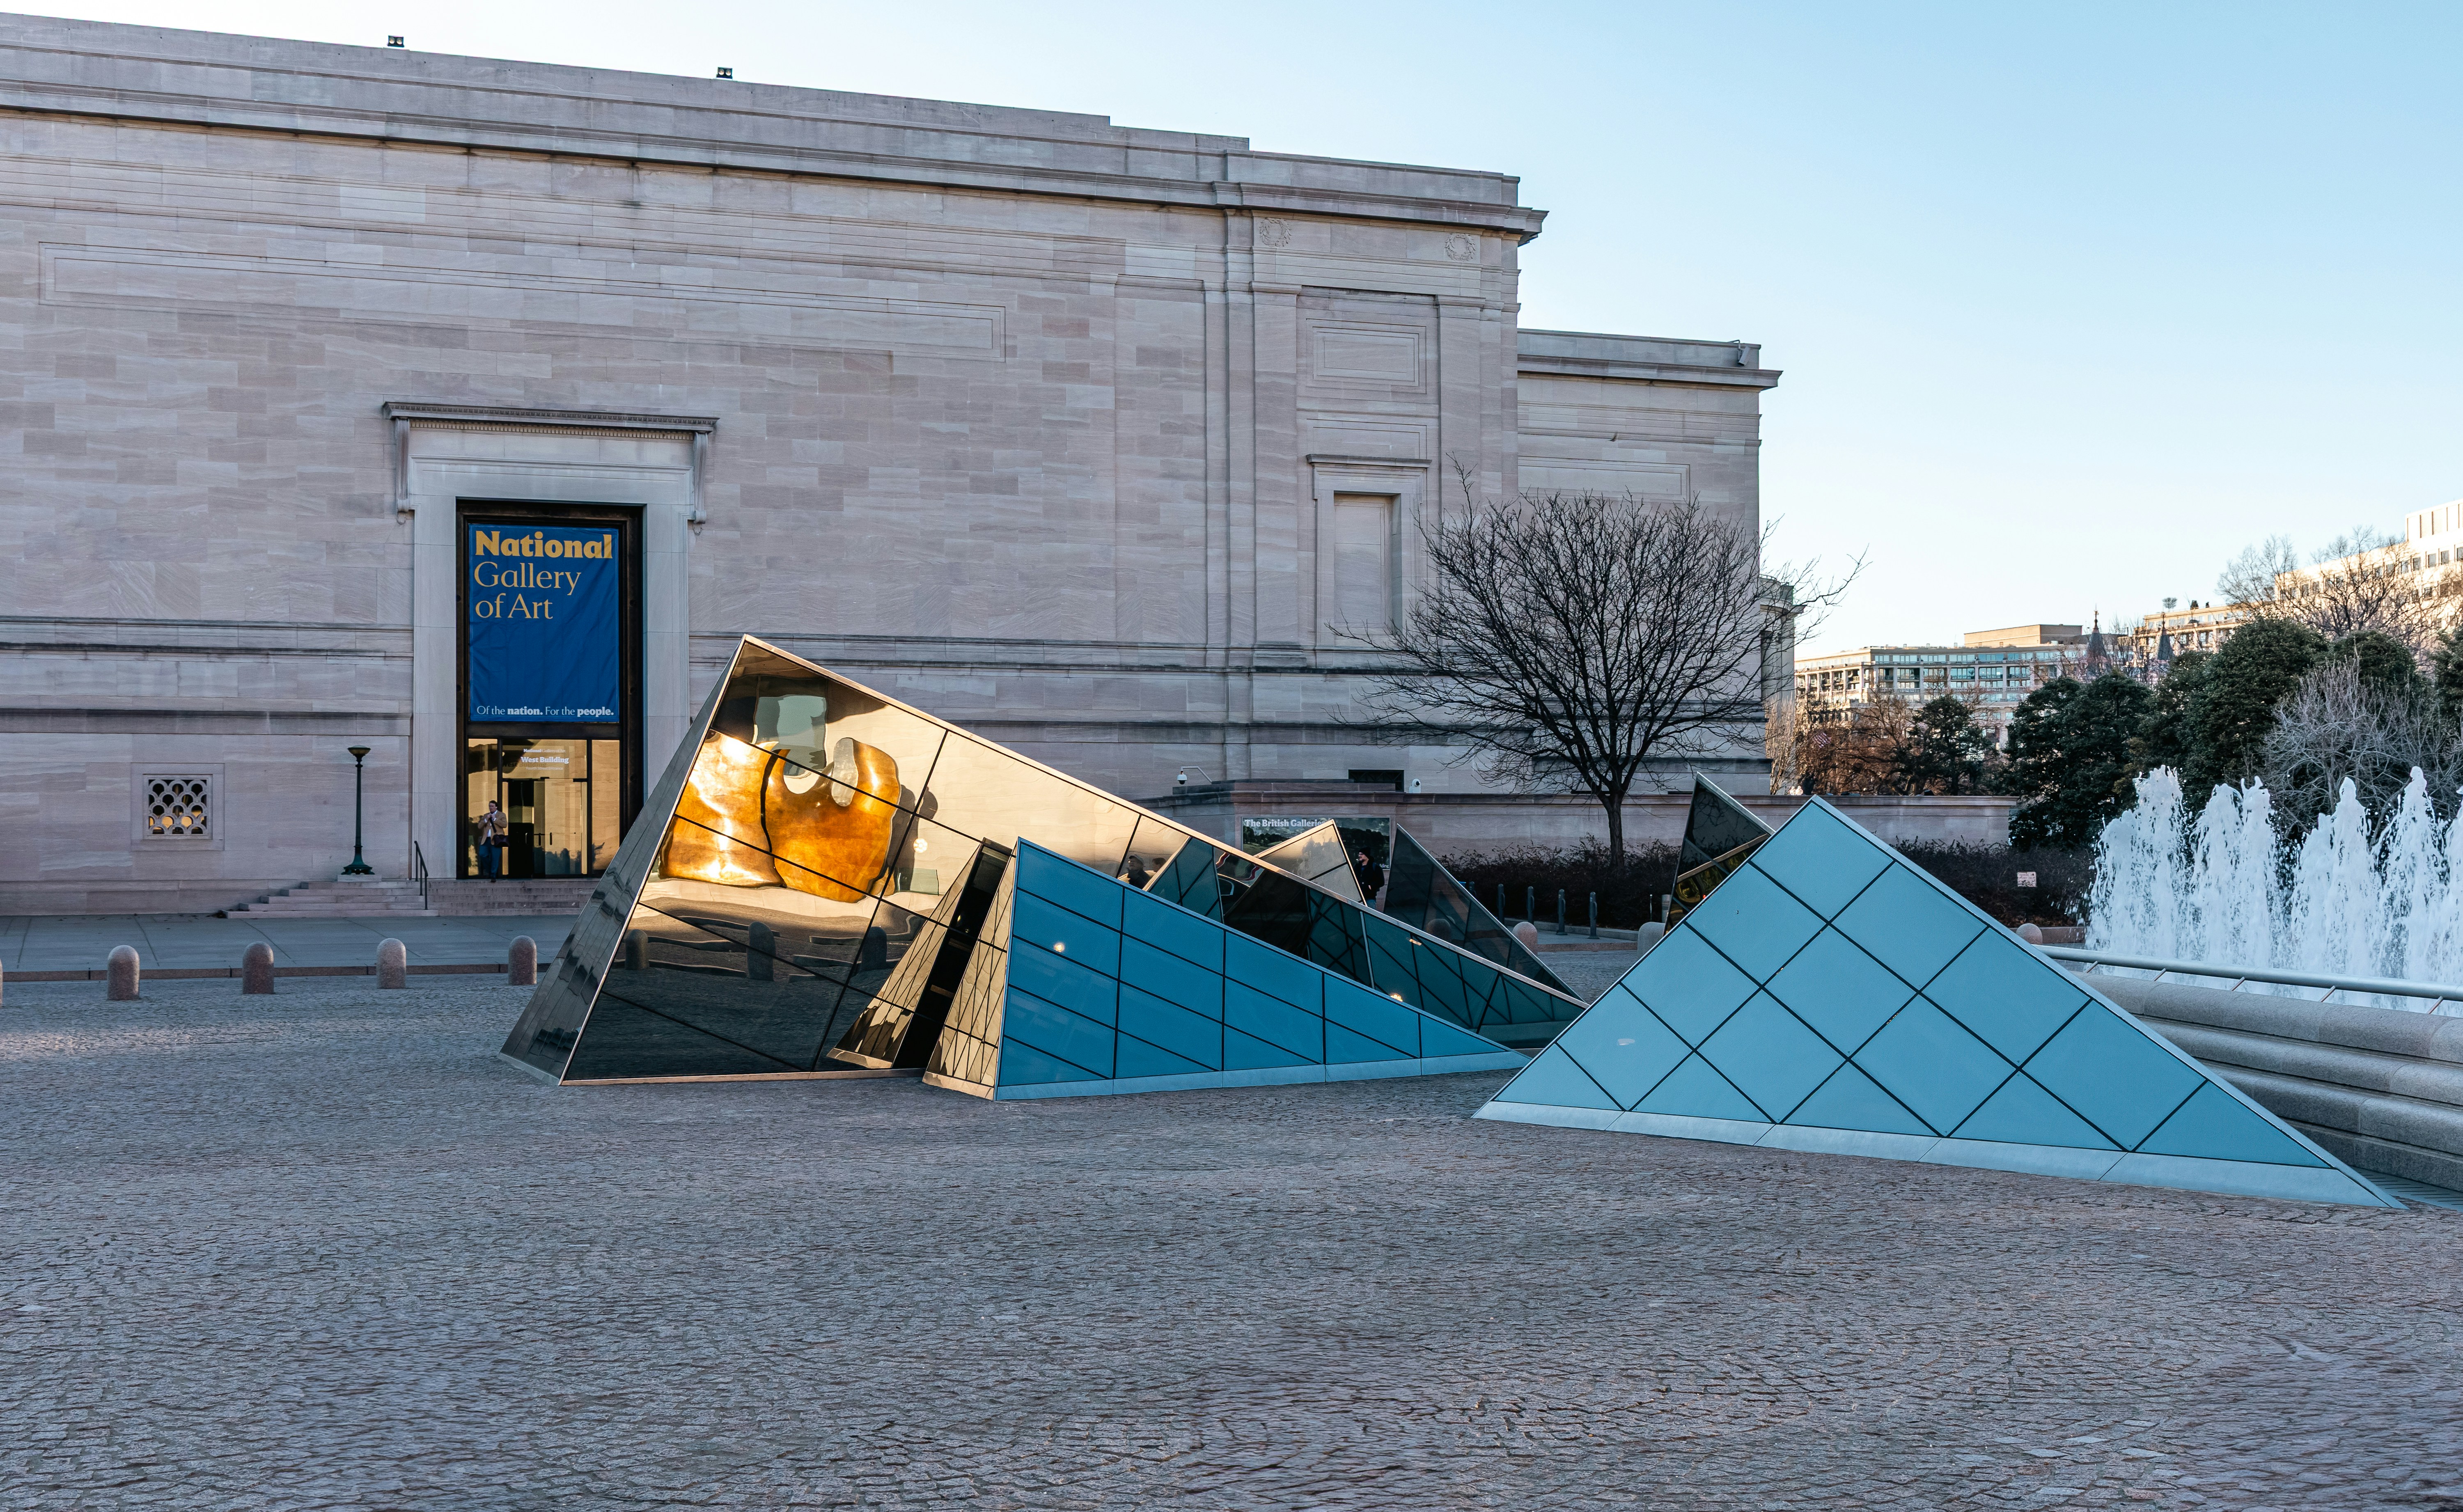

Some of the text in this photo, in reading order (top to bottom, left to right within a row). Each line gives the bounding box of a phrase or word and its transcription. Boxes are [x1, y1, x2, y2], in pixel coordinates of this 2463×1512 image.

[475, 531, 613, 558] National
[474, 561, 582, 596] Gallery
[475, 593, 553, 619] of Art
[477, 706, 614, 717] Of the nation. For the people.
